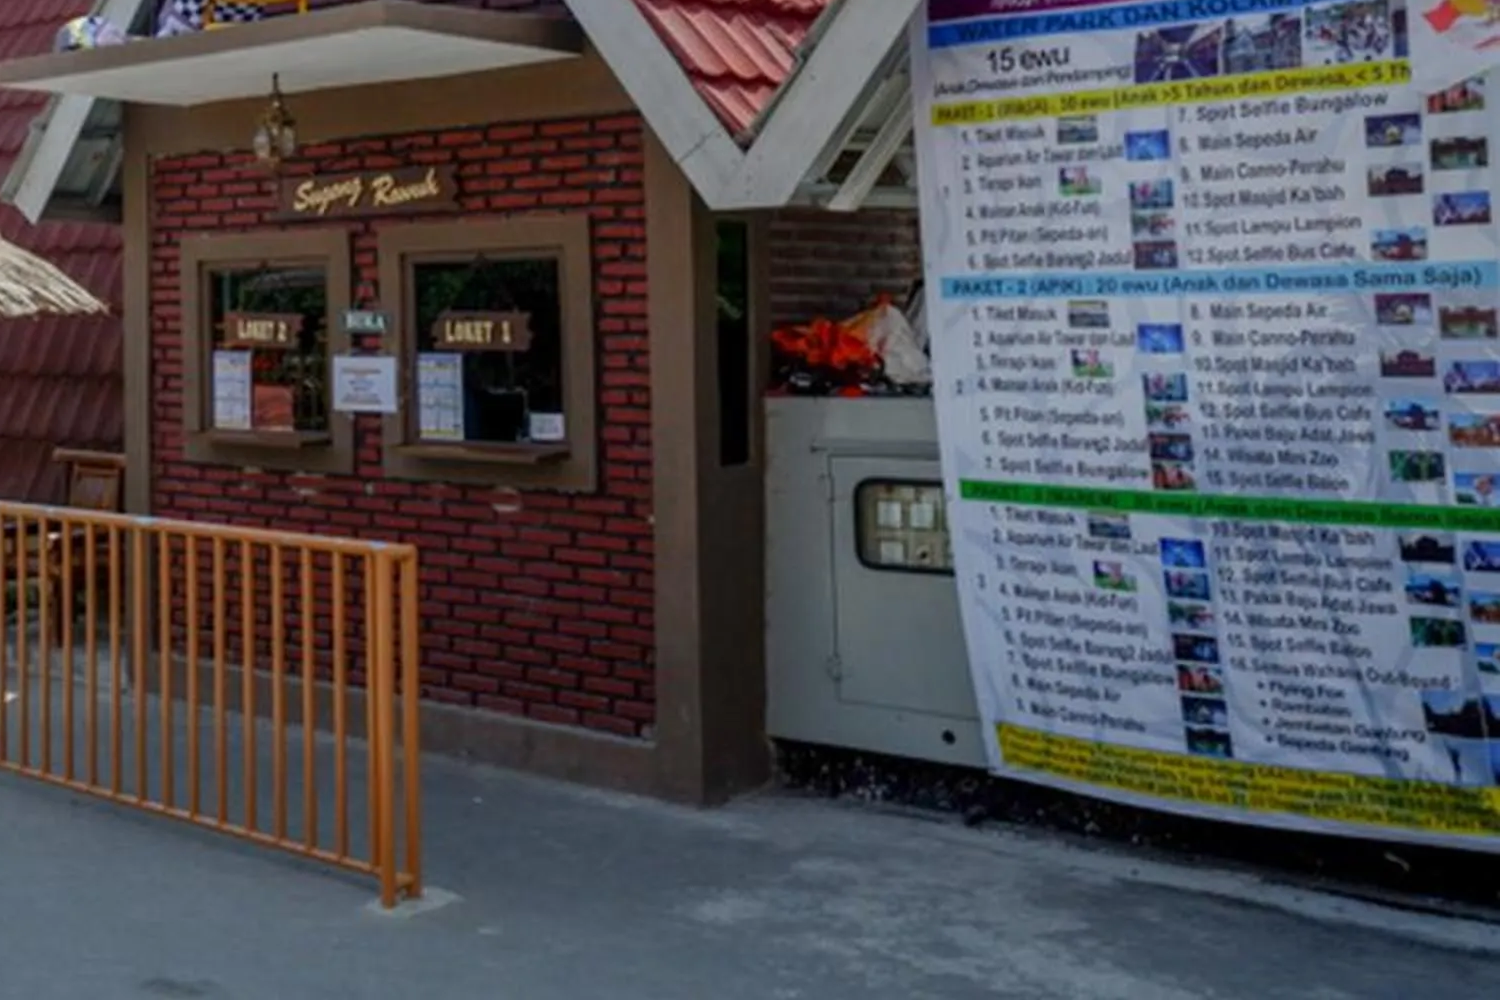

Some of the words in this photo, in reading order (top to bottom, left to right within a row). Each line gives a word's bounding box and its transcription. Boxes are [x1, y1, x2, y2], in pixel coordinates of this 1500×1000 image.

[961, 13, 1046, 43] WATER
[1049, 9, 1117, 34] PARK
[1123, 0, 1181, 24] DAN
[986, 46, 1016, 75] 15
[1019, 46, 1070, 70] ewu
[1184, 81, 1235, 101] Tahun
[1238, 75, 1271, 94] dan
[1370, 67, 1384, 83] 5
[1195, 103, 1237, 124] Spot
[1240, 98, 1291, 119] Selfie
[1294, 91, 1390, 116] Bungalow
[1197, 132, 1233, 150] Main
[1235, 128, 1292, 149] Sepeda
[1294, 125, 1318, 143] Air
[1199, 163, 1235, 182] Main
[1202, 189, 1238, 209] Spot
[1238, 188, 1289, 210] Masjid
[1202, 218, 1239, 238] Spot
[1240, 216, 1292, 237] Lampu
[1293, 212, 1363, 235] Lampion
[1204, 246, 1240, 265] Spot
[1241, 243, 1285, 262] Selfie
[1286, 242, 1317, 260] Bus
[1318, 240, 1357, 259] Cafe
[952, 276, 1002, 295] PAKET
[1016, 276, 1027, 294] 2
[1029, 276, 1084, 295] (APIK)
[1095, 276, 1117, 294] 20
[1123, 279, 1159, 294] ewu
[1163, 274, 1220, 294] (Anak
[1223, 271, 1262, 290] dan
[1265, 269, 1350, 289] Dewasa
[1352, 267, 1416, 287] Sama
[1423, 265, 1484, 290] Saja)
[1017, 304, 1059, 322] Masuk
[1209, 302, 1245, 319] Main
[1246, 302, 1302, 322] Sepeda
[1305, 302, 1328, 318] Air
[237, 319, 274, 340] LOKET
[277, 321, 288, 342] 2
[445, 319, 492, 344] LOKET
[501, 320, 511, 344] 1
[1212, 330, 1246, 346] Main
[1213, 355, 1248, 373] Spot
[1250, 355, 1300, 375] Masjid
[1217, 381, 1251, 398] Spot
[1253, 380, 1304, 399] Lampu
[1306, 380, 1373, 398] Lampion
[1223, 403, 1257, 421] Spot
[1259, 402, 1301, 420] Selfie
[1303, 403, 1333, 420] Bus
[1336, 403, 1372, 421] Cafe
[1264, 425, 1298, 445] Baju
[1301, 426, 1335, 443] Adat
[998, 456, 1032, 474] Spot
[1034, 458, 1074, 474] Selfie
[1268, 681, 1315, 700] Flying
[1316, 685, 1345, 700] Fox
[1274, 715, 1350, 735] Jembatan
[1277, 733, 1337, 752] Sepeda
